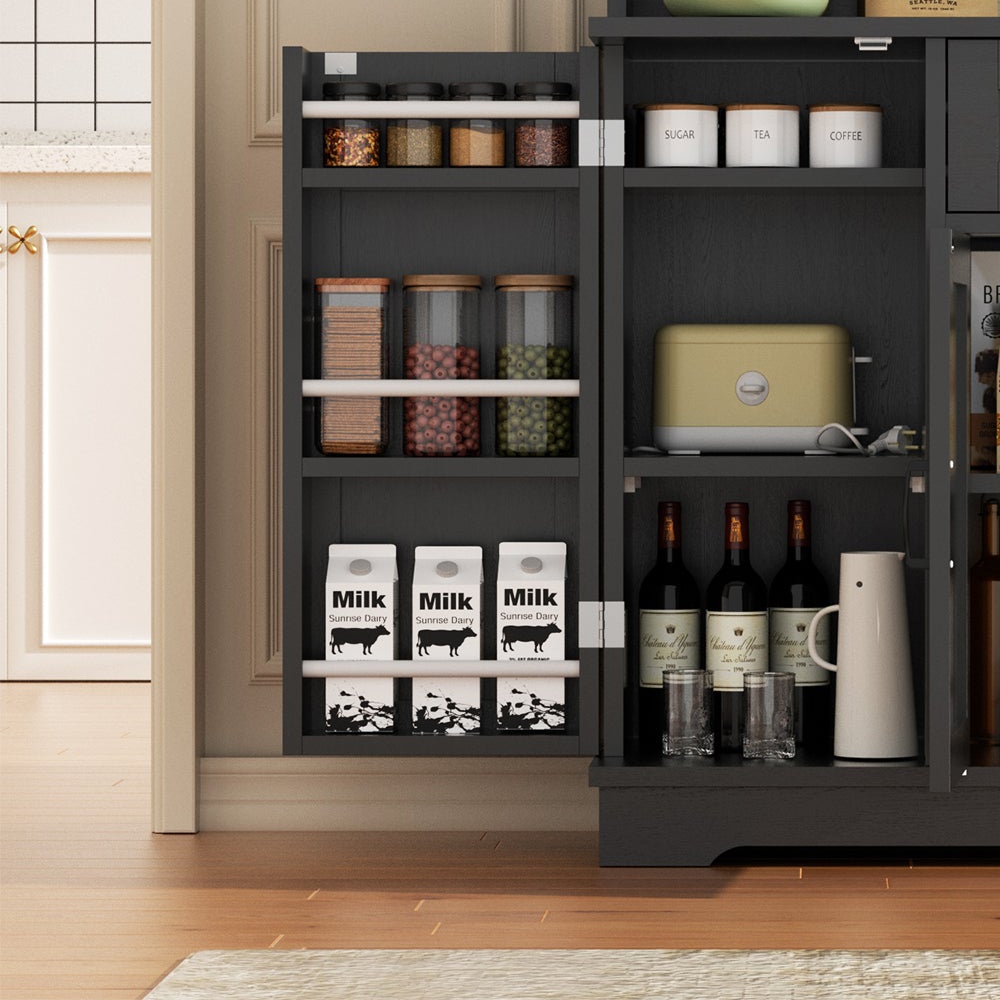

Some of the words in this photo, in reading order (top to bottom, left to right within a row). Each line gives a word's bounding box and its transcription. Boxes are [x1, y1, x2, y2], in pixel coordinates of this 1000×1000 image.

[664, 129, 695, 139] SUGAR
[753, 129, 770, 139] TEA
[829, 131, 862, 141] COFFEE
[332, 590, 386, 608] Milk
[419, 592, 473, 610] Milk
[504, 588, 558, 606] Milk
[328, 614, 363, 623] Sunrise
[364, 614, 388, 624] Dairy
[415, 616, 449, 625] Sunrise
[451, 616, 475, 626] Dairy
[500, 611, 534, 621] Sunrise
[535, 611, 559, 622] Dairy
